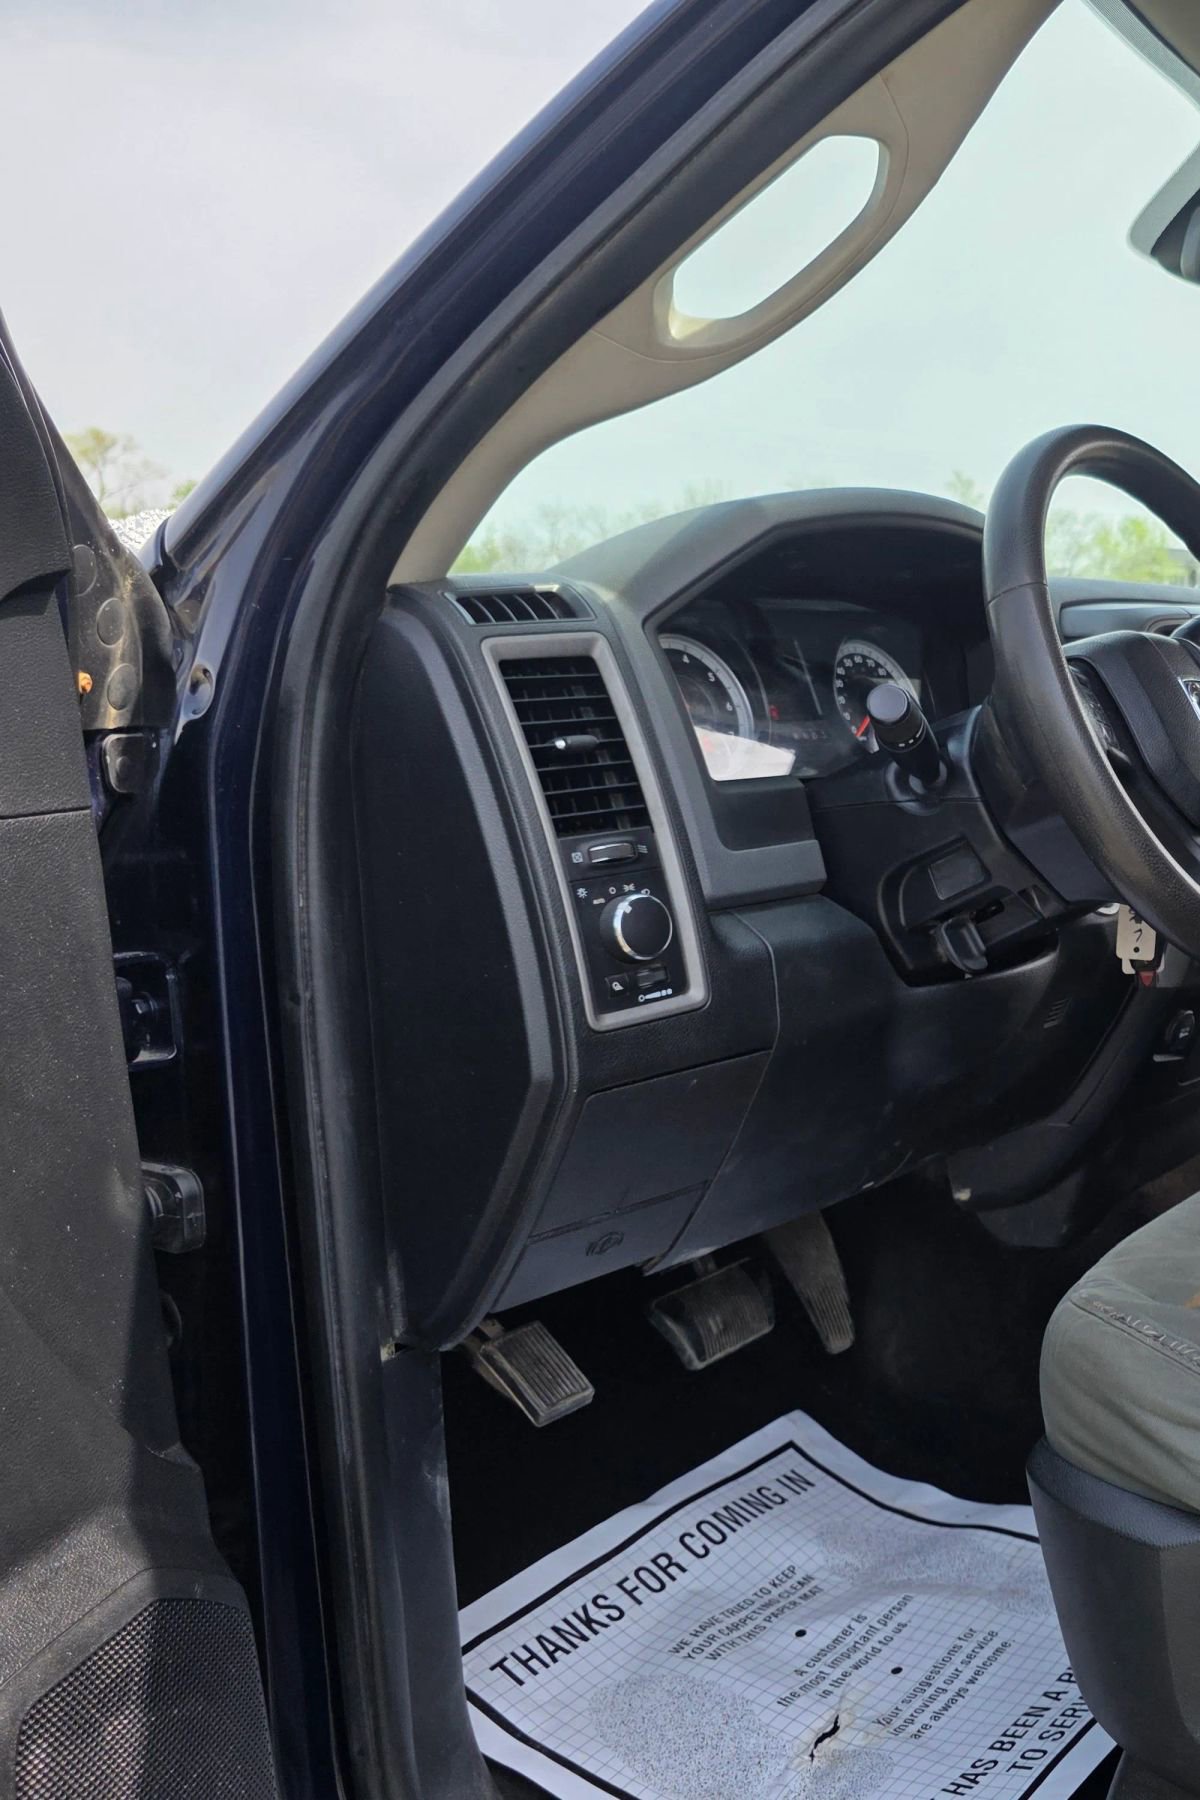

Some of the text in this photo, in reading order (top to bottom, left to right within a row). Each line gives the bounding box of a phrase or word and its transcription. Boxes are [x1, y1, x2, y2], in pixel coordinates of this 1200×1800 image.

[707, 672, 715, 682] 5
[726, 702, 733, 711] 6
[489, 1469, 816, 1687] THANKS FOR COMING IN
[668, 1564, 798, 1655] WE HAVE TRIED TO KEEP
[683, 1573, 816, 1662] YOUR CARPETING CLEAN
[704, 1584, 824, 1662] WITH THIS PAPER MAT
[777, 1594, 914, 1707] the most important person
[794, 1613, 868, 1677] A customer is
[818, 1689, 834, 1699] in
[828, 1671, 852, 1688] the
[850, 1646, 882, 1671] world
[878, 1634, 894, 1646] to
[872, 1627, 977, 1728] Your suggestions for
[887, 1630, 999, 1737] improving our service
[910, 1640, 1016, 1740] are always welcome.
[941, 1758, 999, 1796] HAS
[988, 1706, 1051, 1753] BEEN
[1042, 1691, 1069, 1702] A
[1006, 1748, 1049, 1773] TO
